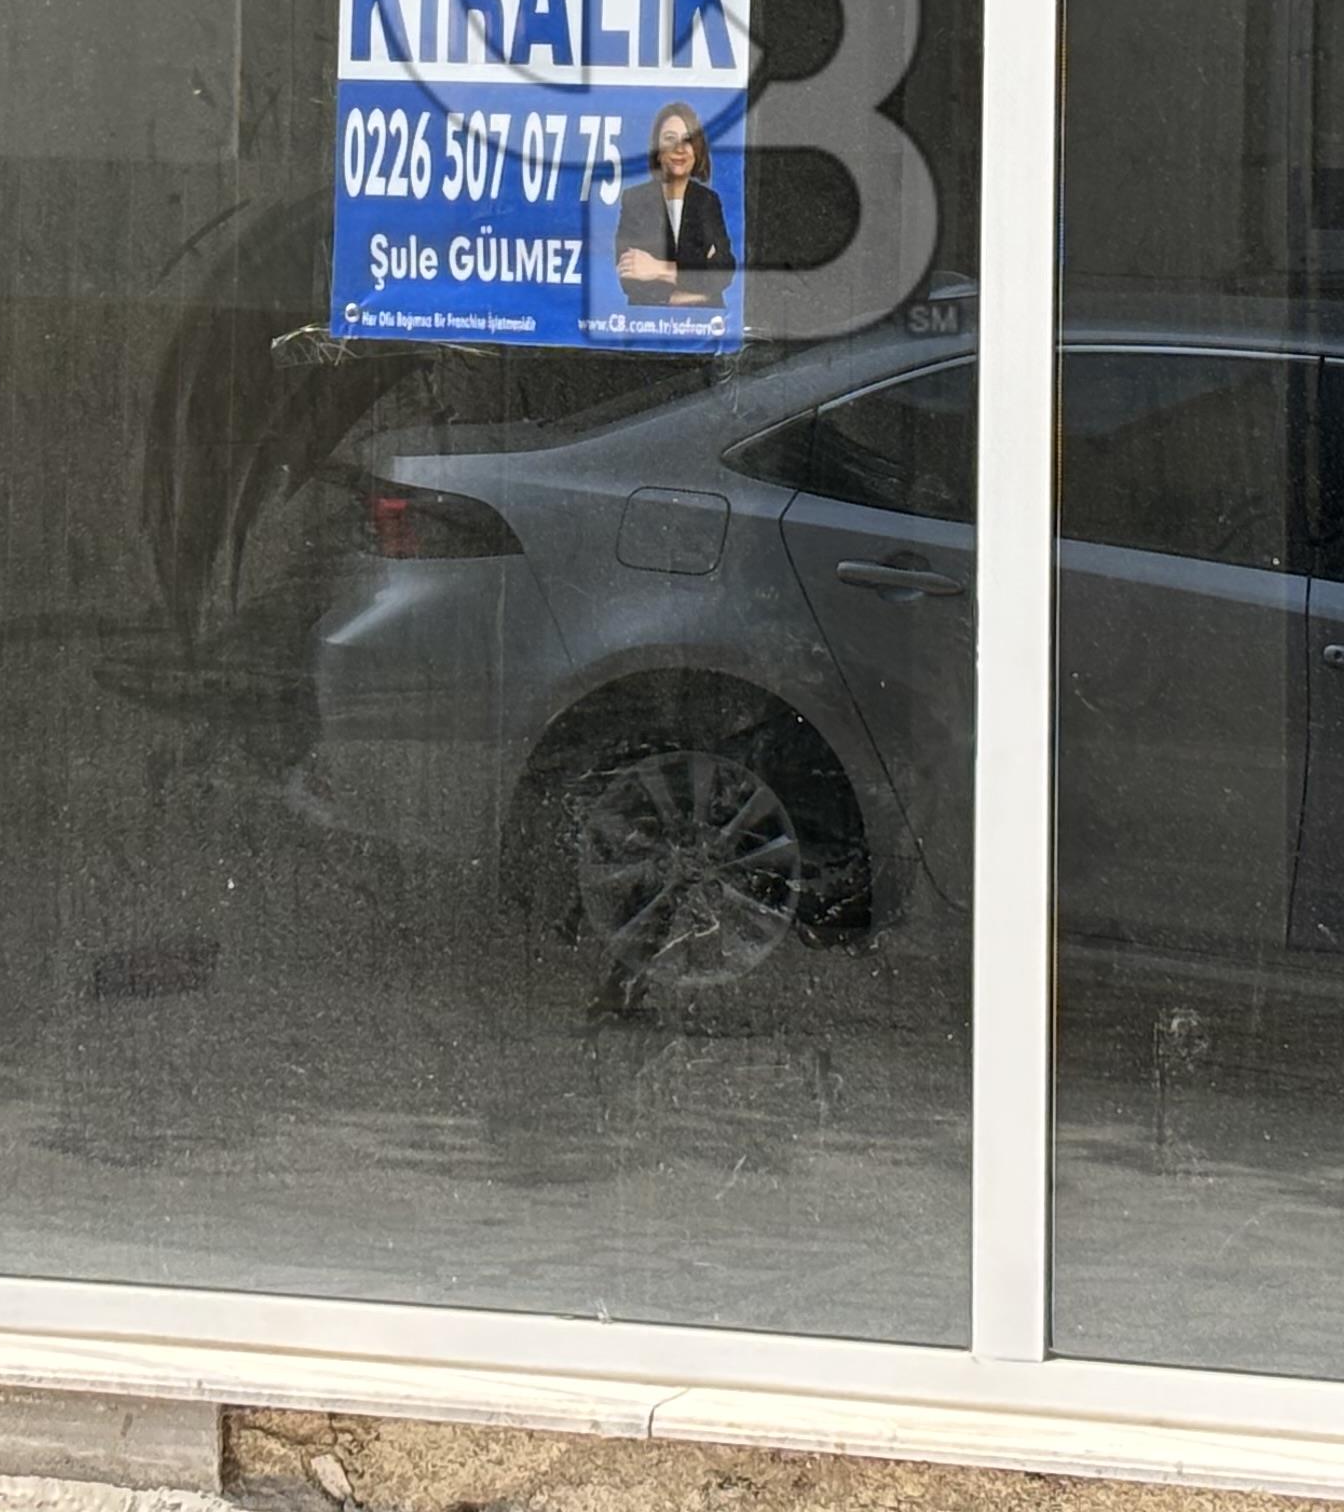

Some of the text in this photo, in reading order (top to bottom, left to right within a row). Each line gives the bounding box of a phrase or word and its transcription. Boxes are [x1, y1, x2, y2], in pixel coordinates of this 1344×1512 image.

[344, 108, 622, 205] 0226 507 07 75
[370, 225, 583, 291] Şule GÜLMEZ
